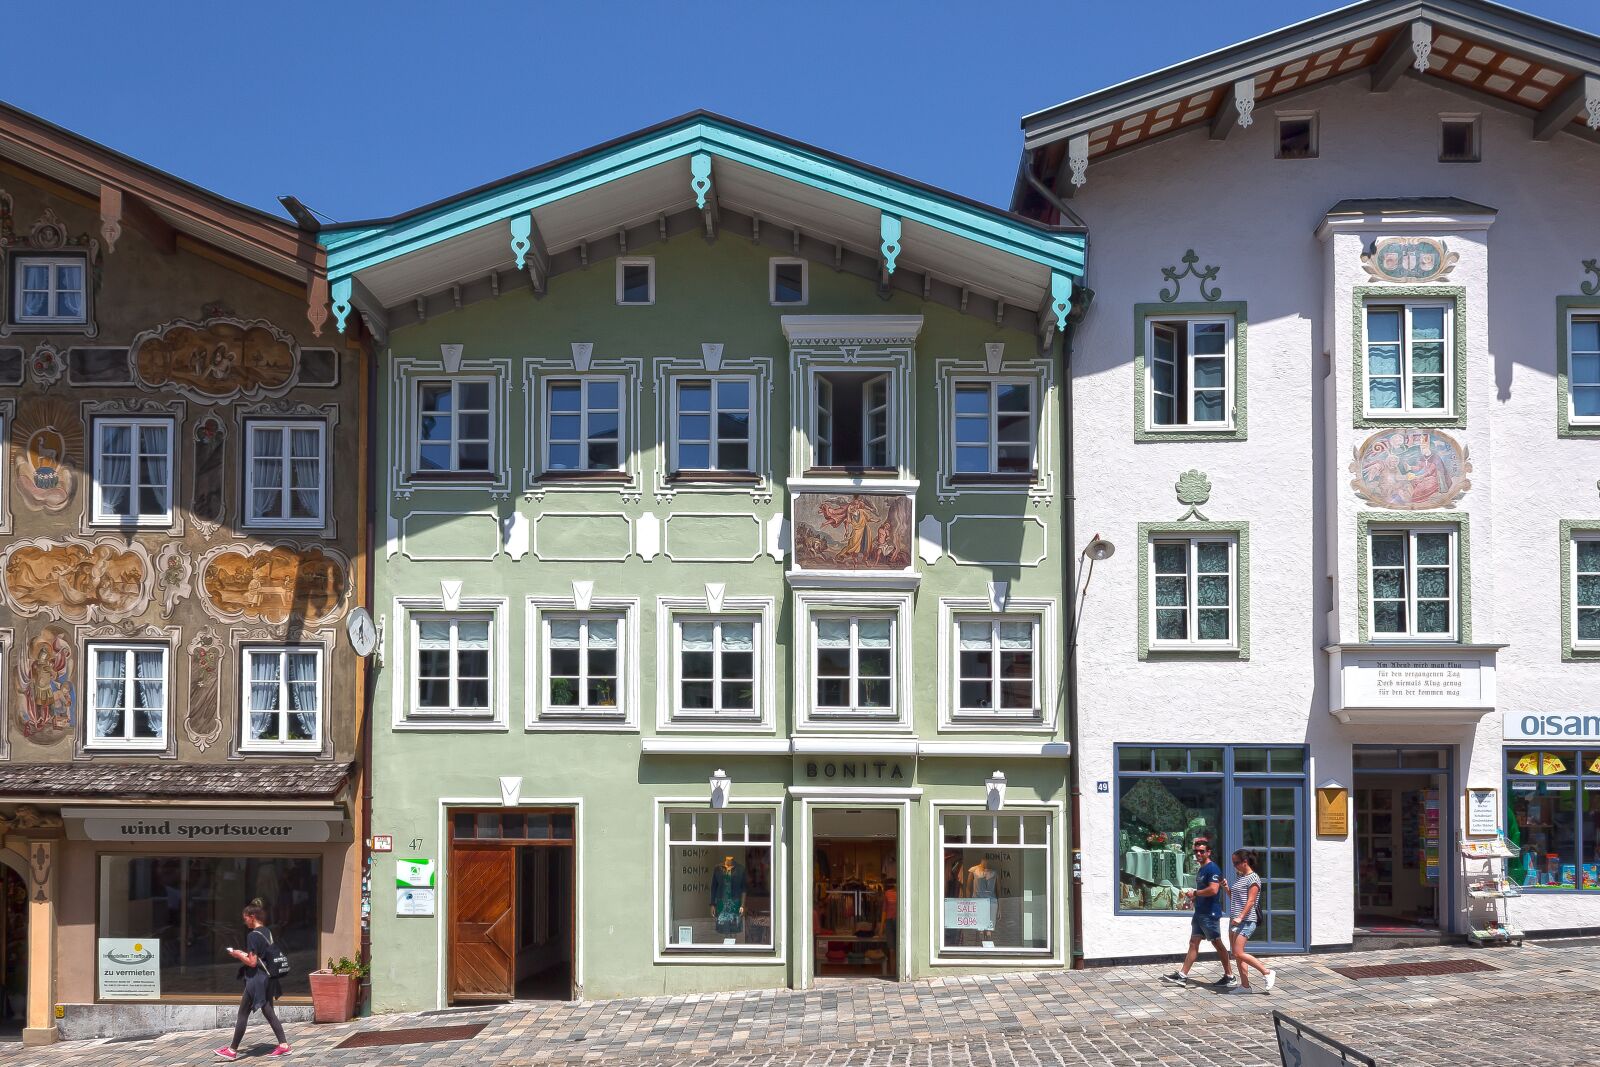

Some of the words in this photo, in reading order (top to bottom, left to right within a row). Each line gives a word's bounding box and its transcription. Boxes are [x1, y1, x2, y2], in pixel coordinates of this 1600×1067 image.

[1390, 661, 1411, 669] Abend
[1446, 670, 1461, 678] Tag
[1376, 679, 1394, 687] Doch
[1378, 688, 1389, 696] für
[1391, 688, 1403, 696] den
[1405, 688, 1416, 696] der
[806, 761, 904, 778] BONITA
[1098, 783, 1108, 791] 49
[120, 821, 171, 835] wind
[177, 822, 293, 838] sportswear
[408, 838, 424, 850] 47
[682, 848, 709, 857] BONITA
[682, 865, 709, 875] BONITA
[957, 905, 977, 913] SALE
[957, 917, 977, 926] 50%
